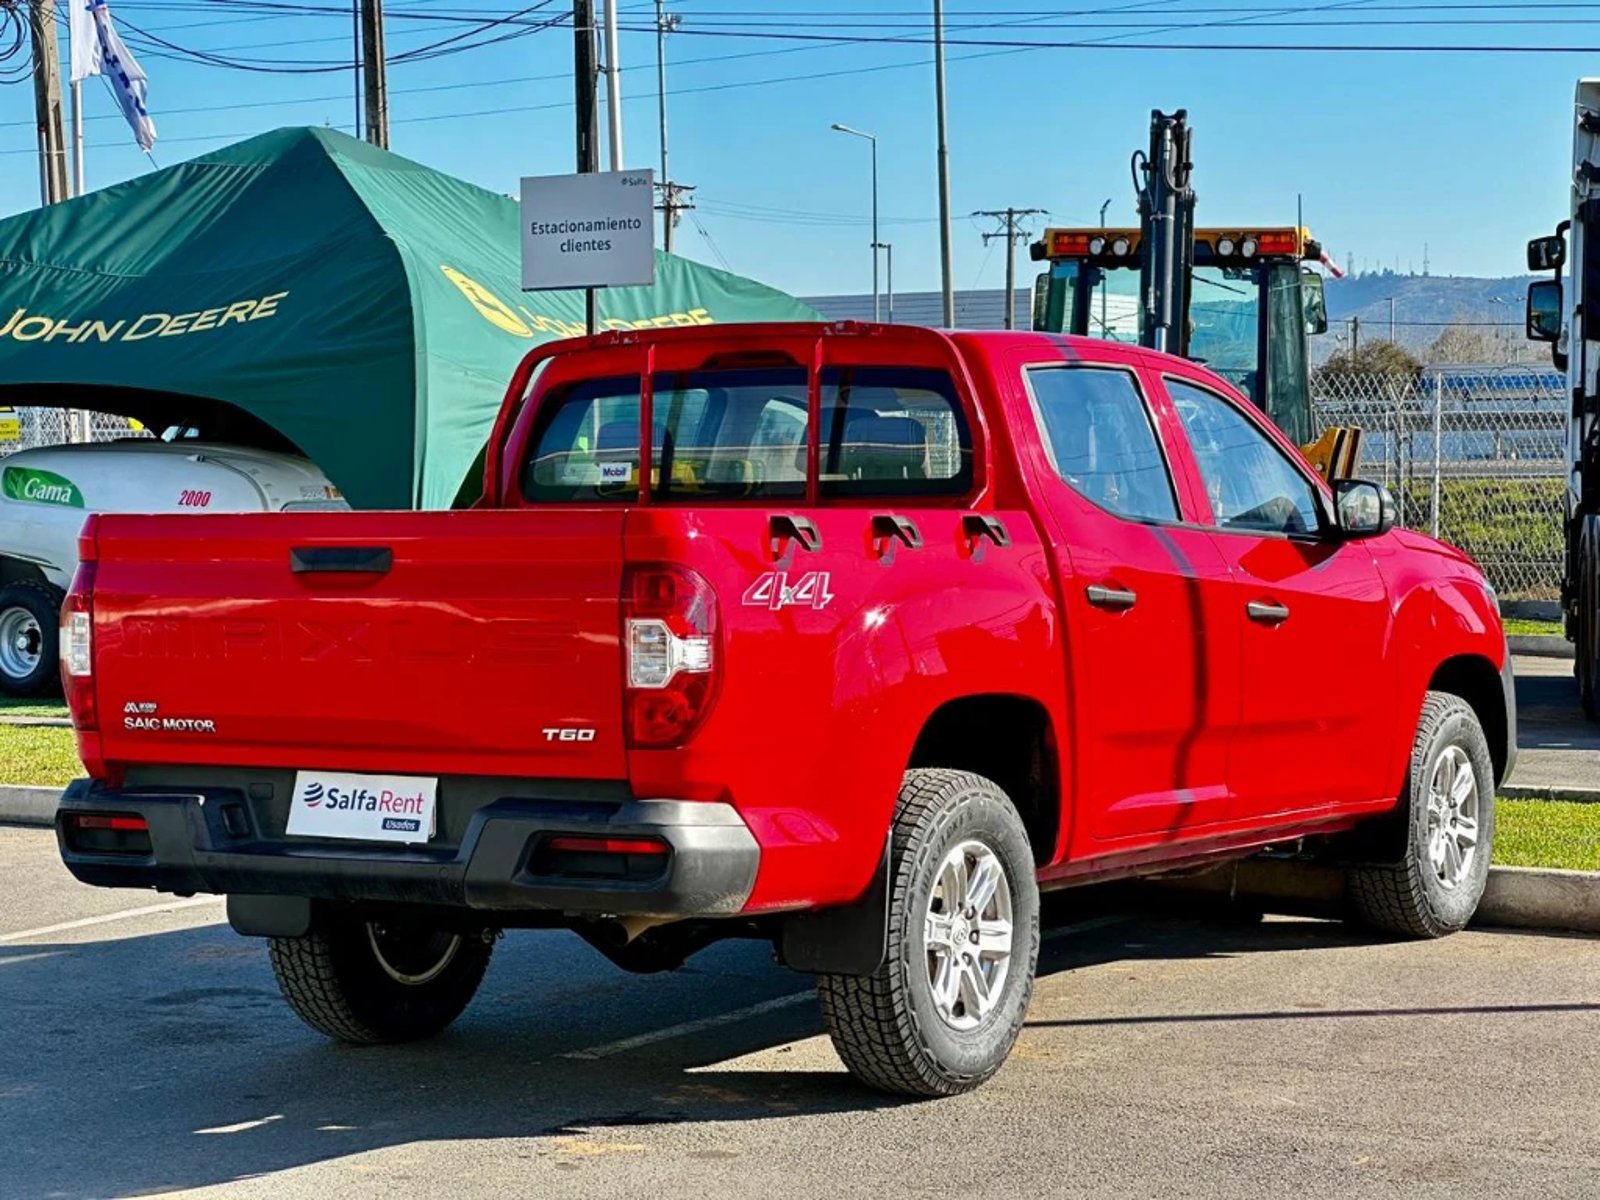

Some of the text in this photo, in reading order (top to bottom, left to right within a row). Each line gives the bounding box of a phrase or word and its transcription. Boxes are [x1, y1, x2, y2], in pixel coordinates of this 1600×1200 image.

[530, 217, 642, 235] Estacionamiento
[560, 239, 612, 252] clientes
[0, 290, 290, 343] JOHN DEERE
[602, 467, 626, 477] Mobil
[24, 477, 72, 503] Gama
[178, 490, 212, 507] 2000
[742, 571, 834, 610] 4x4
[124, 717, 217, 732] SAIC MOTOR
[542, 728, 596, 741] T60
[325, 787, 424, 814] SalfaRent
[385, 819, 417, 830] Usados
